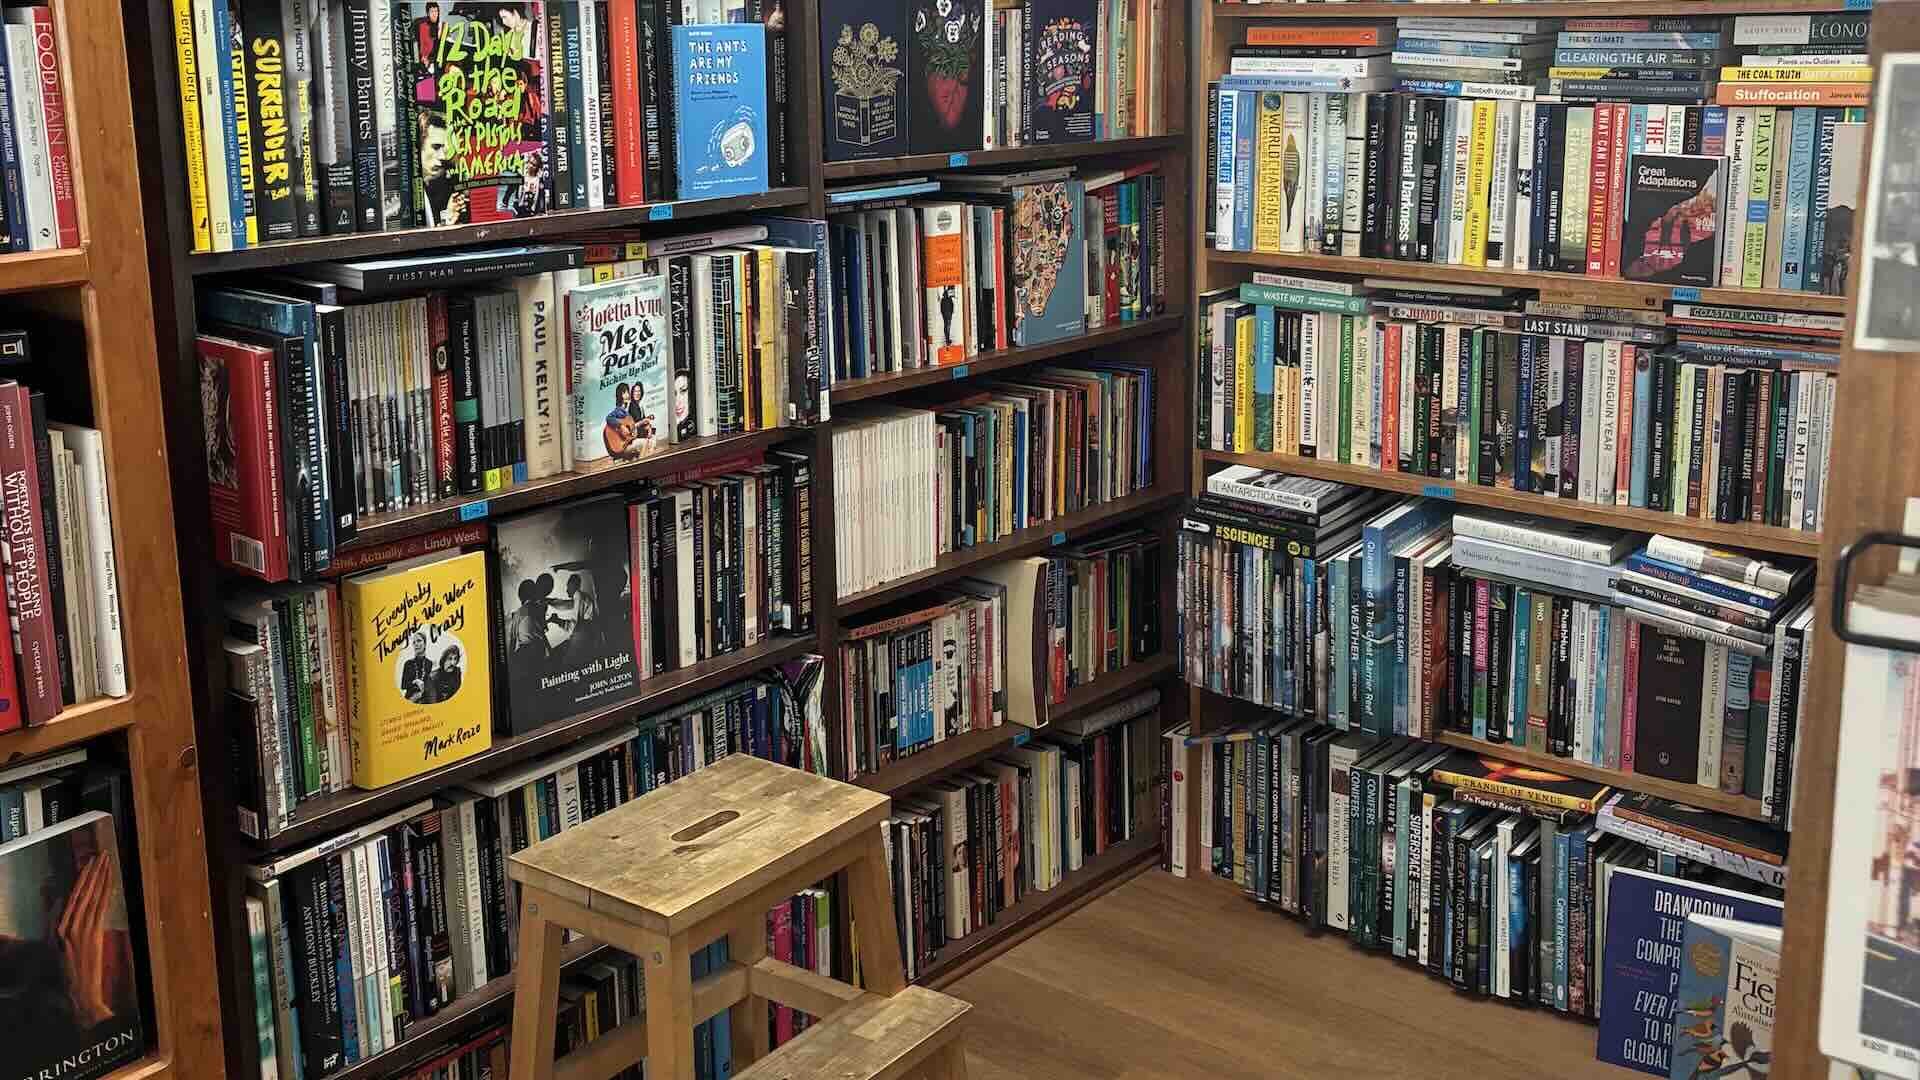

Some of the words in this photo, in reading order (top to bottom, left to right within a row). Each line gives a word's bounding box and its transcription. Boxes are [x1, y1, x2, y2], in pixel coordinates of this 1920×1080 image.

[181, 9, 193, 44] Jerry
[348, 6, 371, 71] Jimmy
[378, 7, 392, 58] INNER
[1038, 32, 1083, 53] READING
[35, 22, 58, 84] FOOD
[184, 48, 193, 65] on
[437, 22, 466, 68] 12
[551, 15, 563, 77] TOGETHER
[567, 27, 580, 80] TRAGEDY
[689, 41, 712, 54] THE
[715, 39, 747, 53] ANTS
[1024, 42, 1032, 81] SEASONS
[1558, 51, 1611, 65] CLEARING
[1614, 52, 1636, 66] THE
[1639, 53, 1667, 67] AIR
[470, 55, 517, 95] the
[689, 58, 713, 70] ARE
[717, 56, 733, 69] MY
[689, 73, 739, 86] FRIENDS
[1047, 53, 1091, 72] SEASONS
[1736, 69, 1752, 82] THE
[1752, 69, 1773, 82] COAL
[1774, 69, 1802, 81] TRUTH
[186, 70, 198, 102] Jerry
[381, 63, 393, 111] SONG
[554, 78, 566, 112] ALONE
[1734, 87, 1821, 103] Stuffocation
[252, 38, 289, 185] SURRENDER
[356, 76, 374, 141] Barnes
[442, 89, 522, 123] Road
[588, 97, 597, 141] ANTHONY
[602, 92, 613, 121] NEIL
[1598, 108, 1610, 137] WHAT
[556, 126, 566, 144] JEFF
[604, 123, 615, 147] FINN
[1369, 122, 1379, 146] THE
[1646, 117, 1665, 145] THE
[1669, 125, 1682, 148] GREAT
[1686, 112, 1698, 153] FEELING
[1735, 116, 1747, 137] Rich
[1755, 113, 1773, 160] PLAN
[590, 144, 599, 180] CALLEA
[1401, 132, 1418, 178] Eternal
[1456, 135, 1469, 156] FIVE
[1597, 140, 1608, 161] CAN
[1732, 139, 1745, 165] Land,
[1265, 112, 1281, 225] WORLDCHANGING
[1347, 152, 1361, 182] THE
[1367, 150, 1378, 198] MONKEY
[1455, 159, 1468, 187] TIMES
[1594, 169, 1606, 191] DO?
[1637, 175, 1698, 189] Adaptations
[1638, 166, 1667, 178] Great
[1754, 162, 1770, 173] B
[1814, 115, 1836, 218] HEARTS&MINDS
[1728, 165, 1743, 211] Wasteland
[1752, 176, 1767, 195] 4.0
[1344, 189, 1360, 223] GAP
[1366, 203, 1376, 234] WARS
[1398, 180, 1416, 242] Darkness
[1453, 189, 1467, 222] FASTER
[1592, 193, 1604, 219] JANE
[1590, 223, 1603, 255] FONDA
[388, 270, 426, 282] FIRST
[428, 268, 455, 279] MAN
[584, 300, 632, 334] Loretta
[633, 295, 664, 321] Lynn
[806, 278, 816, 340] ENCYCLOPEDIA
[1262, 291, 1289, 304] WASTE
[1288, 293, 1305, 306] NOT
[1406, 307, 1444, 322] JUMBO
[533, 300, 546, 353] PAUL
[600, 324, 637, 359] Me
[638, 318, 654, 343] &
[1523, 319, 1552, 335] LAST
[1553, 322, 1590, 338] STAND
[600, 340, 659, 381] Patsy
[806, 347, 820, 380] PUNK
[1460, 337, 1470, 359] PART
[1520, 338, 1532, 380] TRESEDER
[1606, 348, 1617, 366] MY
[1431, 373, 1441, 395] killer
[1539, 344, 1551, 399] SURVIVING
[536, 359, 551, 419] KELLY
[1458, 390, 1469, 418] PRIDE
[1604, 368, 1617, 420] PENGUIN
[1725, 376, 1737, 417] CLIMATE
[264, 390, 275, 431] Wrightson
[1275, 393, 1286, 440] Washington
[1430, 396, 1441, 438] ANIMALS
[1537, 399, 1549, 441] GALERAS
[1777, 407, 1788, 427] BLUE
[1797, 419, 1808, 434] 18
[467, 424, 478, 455] Richard
[1603, 422, 1616, 452] YEAR
[1654, 421, 1664, 449] AMAZON
[1776, 428, 1787, 460] DESERT
[1653, 450, 1664, 479] JOURNAL
[1742, 448, 1753, 481] COLLAPSE
[1793, 443, 1808, 501] MILES
[16, 469, 33, 534] PORTRAITS
[309, 479, 322, 521] AQUAMAN
[1220, 484, 1278, 502] ANTARCTICA
[3, 471, 25, 556] WITHOUT
[14, 559, 35, 621] PEOPLE
[23, 536, 37, 571] FROM
[423, 536, 452, 551] Lindy
[453, 529, 481, 544] West
[1222, 526, 1269, 549] SCIENCE
[28, 582, 41, 618] LAND
[1396, 579, 1405, 592] THE
[1396, 591, 1406, 612] ENDS
[1423, 580, 1433, 624] HEALING
[372, 581, 431, 636] Everybody
[373, 622, 421, 663] Thought
[422, 603, 441, 622] We
[443, 579, 475, 606] Were
[429, 605, 465, 644] Crazy
[1536, 601, 1545, 622] WHO
[1350, 604, 1361, 660] WEATHER
[1364, 629, 1375, 657] Great
[1463, 610, 1472, 656] STARWARE
[1560, 607, 1571, 662] HushHush
[1396, 638, 1405, 664] EARTH
[1423, 629, 1433, 675] GARDENS
[541, 672, 579, 689] Painting
[581, 663, 602, 677] with
[604, 653, 630, 672] Light
[1364, 658, 1376, 692] Barrier
[1534, 664, 1543, 686] WHAT
[1780, 662, 1793, 708] DOUGLAS
[1364, 692, 1376, 716] Reef
[423, 736, 454, 761] Mark
[1777, 711, 1789, 754] MAWSON
[1223, 755, 1232, 785] Transition
[1271, 744, 1280, 768] URBAN
[1271, 769, 1280, 788] PEST
[1291, 775, 1300, 798] Delta
[1350, 770, 1361, 819] CONIFERS
[1463, 778, 1505, 796] TRANSIT
[1527, 790, 1563, 806] VENUS
[1223, 786, 1232, 818] Handbook
[1271, 789, 1280, 823] CONTROL
[1365, 778, 1376, 826] CONIFERS
[1387, 783, 1397, 833] NATURE'S
[1270, 834, 1279, 873] AUSTRALIA
[1408, 813, 1421, 879] SUPERSPACE
[1455, 843, 1467, 890] GREAT
[1384, 872, 1393, 912] EVENTS
[1653, 888, 1735, 922] DRAWDOWN
[1556, 898, 1567, 923] Green
[302, 905, 318, 956] ANTHONY
[1454, 892, 1466, 965] MIGRATIONS
[1659, 917, 1682, 944] THE
[1555, 925, 1567, 970] Inheritance
[306, 956, 322, 1004] BUCKLEY
[1634, 989, 1667, 1020] EVER
[1643, 1018, 1660, 1041] TO
[1623, 1037, 1671, 1071] GLOBAL
